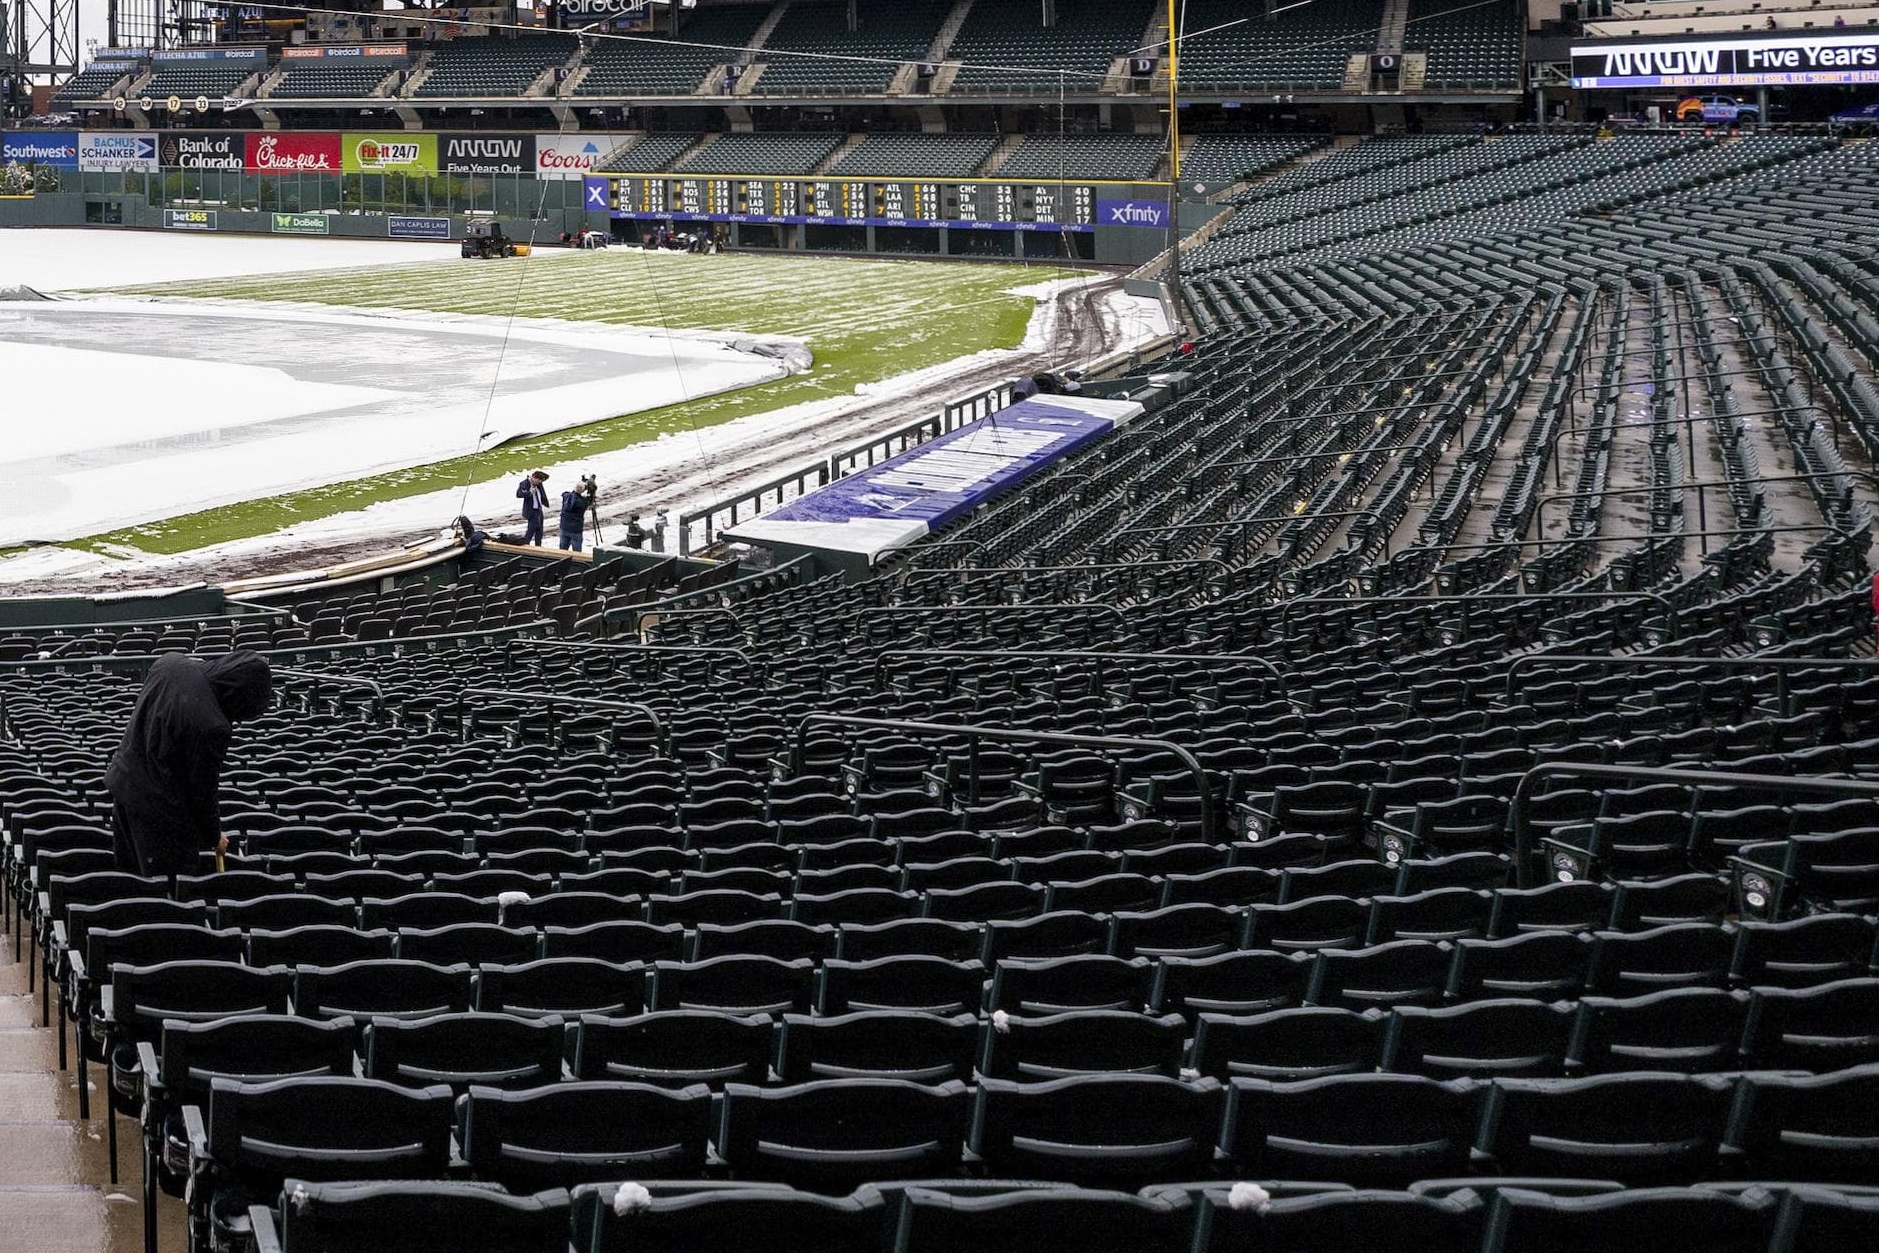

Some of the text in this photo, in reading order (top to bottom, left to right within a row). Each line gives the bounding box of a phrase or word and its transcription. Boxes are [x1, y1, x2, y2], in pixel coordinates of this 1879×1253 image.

[1380, 57, 1394, 68] O
[1604, 45, 1877, 76] ARROW Five Years
[95, 138, 136, 148] BACHUS
[179, 137, 229, 153] Bank of
[3, 144, 67, 158] Southwest
[361, 145, 418, 159] Fix-it 24/7
[448, 140, 522, 157] ARROW
[82, 148, 136, 159] SCHANKER
[87, 158, 113, 167] INJURY
[179, 154, 243, 169] Colorado
[539, 149, 591, 169] Coors
[448, 163, 521, 173] Five Years Out
[684, 180, 697, 188] MIL
[748, 181, 763, 189] SEA
[886, 184, 901, 192] ATL
[959, 185, 977, 193] CHC
[1036, 186, 1047, 195] A's
[748, 190, 763, 198] TEX
[886, 193, 902, 201] LAA
[960, 194, 970, 202] TB
[749, 199, 764, 207] LAD
[1036, 196, 1054, 204] NYY
[960, 204, 976, 212] CIN
[1036, 206, 1051, 214] DET
[173, 211, 207, 222] bet365
[817, 209, 834, 217] WSH
[887, 211, 904, 219] NYM
[960, 213, 977, 221] MIA
[1111, 203, 1161, 225] xfinity
[293, 217, 324, 228] DaBella
[1037, 215, 1055, 223] MIN
[391, 221, 447, 230] DAN CAPLIS LAW
